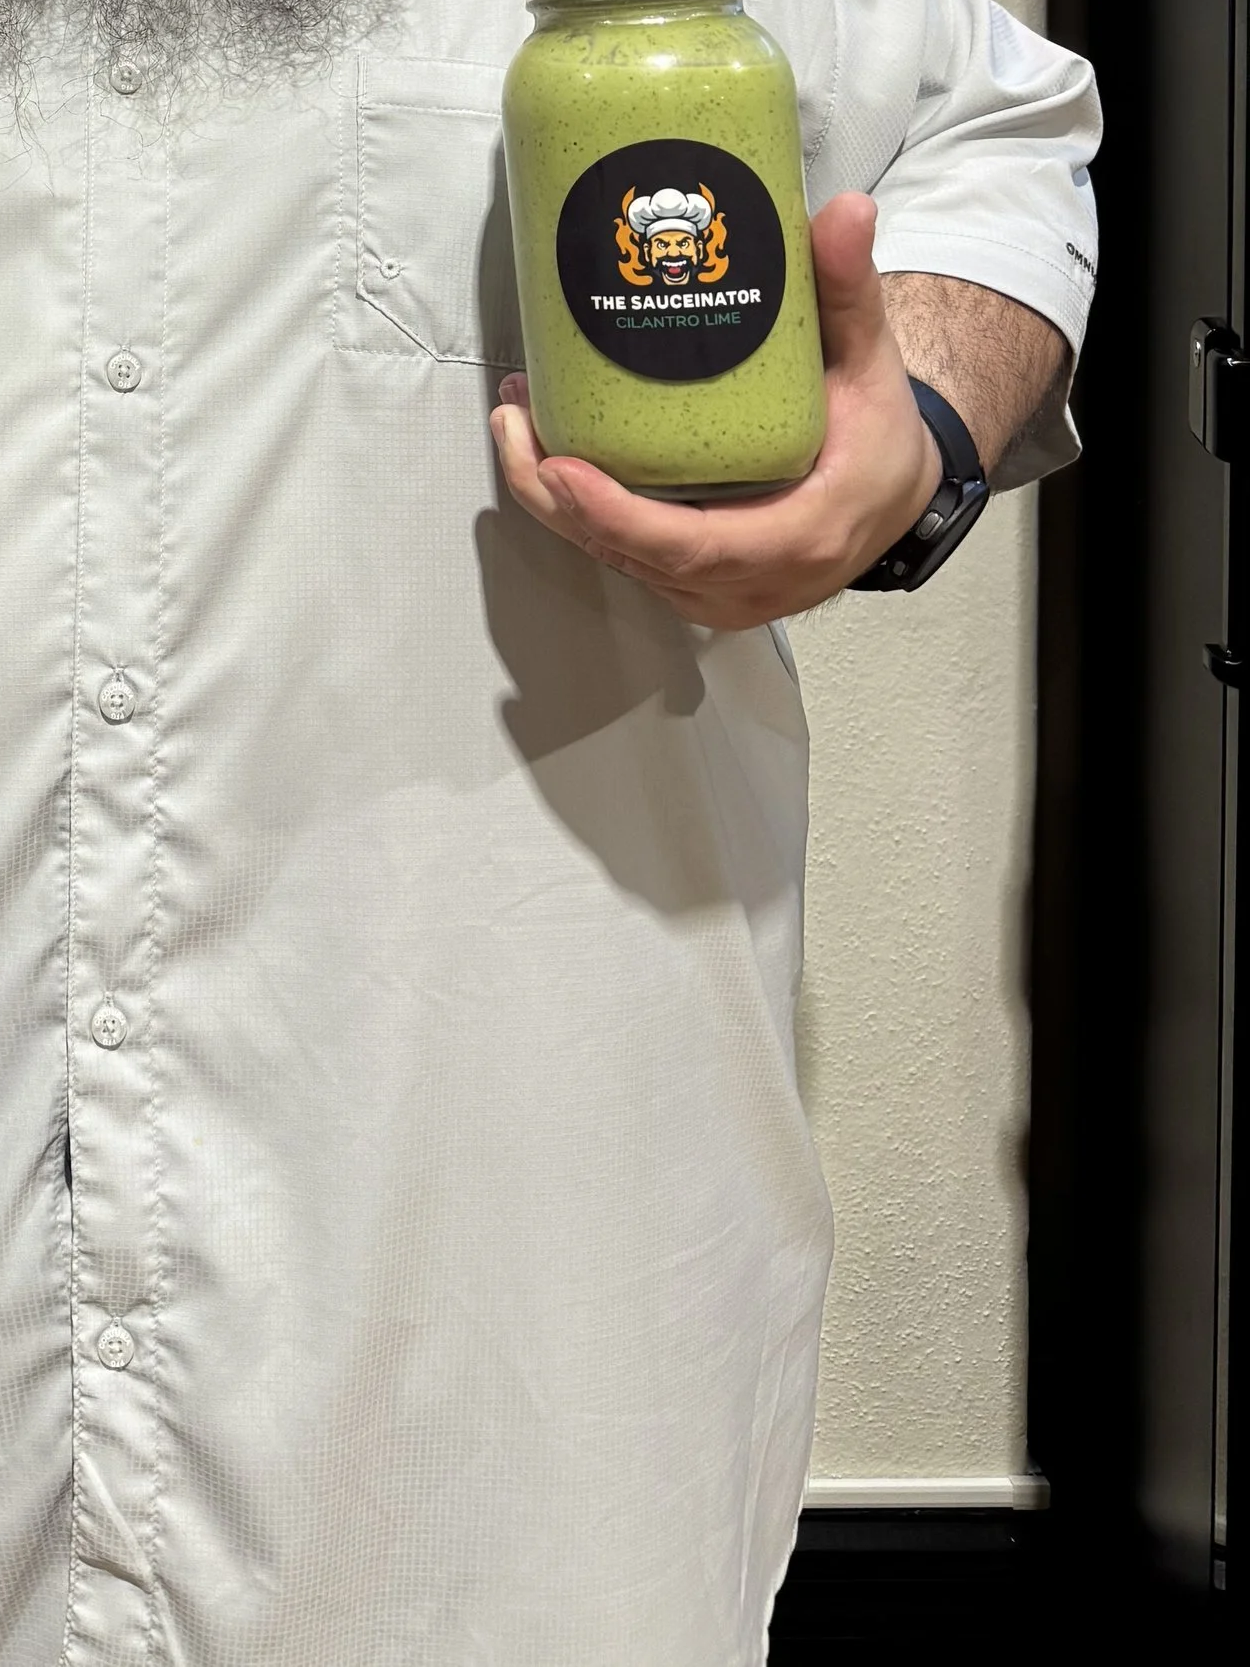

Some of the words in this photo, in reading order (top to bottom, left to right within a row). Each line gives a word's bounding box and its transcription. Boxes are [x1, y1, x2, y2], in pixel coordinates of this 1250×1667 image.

[591, 295, 627, 310] THE
[631, 289, 762, 310] SAUCEINATOR
[616, 315, 700, 329] CILANTRO
[704, 311, 742, 326] LIME
